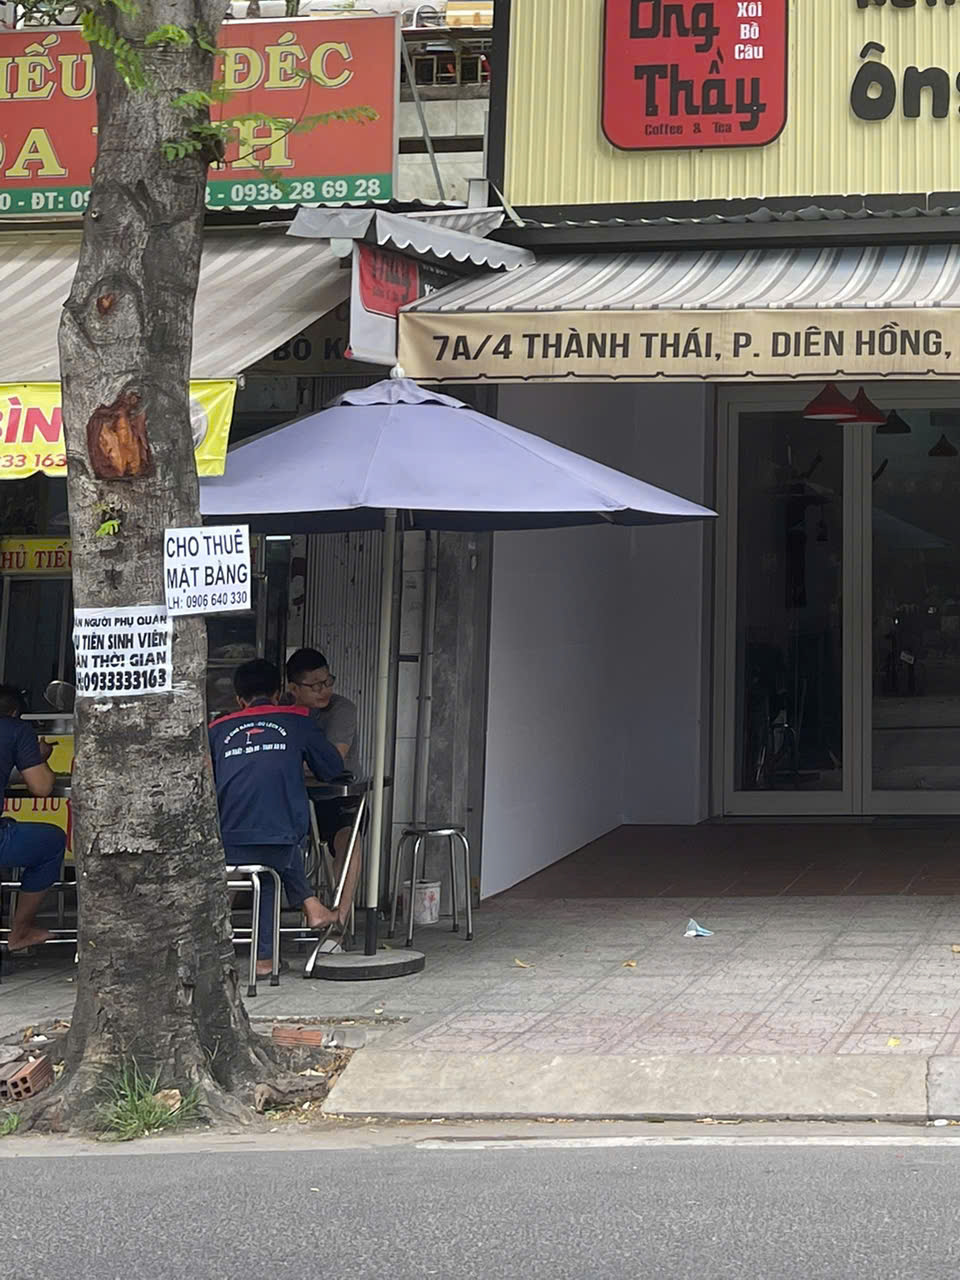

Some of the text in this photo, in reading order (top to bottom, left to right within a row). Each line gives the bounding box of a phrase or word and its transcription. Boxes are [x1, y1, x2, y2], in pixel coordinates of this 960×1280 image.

[737, 1, 762, 17] Xôi
[218, 31, 354, 91] ĐÉC
[734, 43, 764, 60] Câu
[634, 47, 767, 131] Thầy
[644, 121, 732, 136] Coffee & Tea
[0, 127, 69, 179] A
[31, 192, 64, 210] ĐT:
[231, 183, 283, 202] 0938
[288, 181, 316, 200] 28
[321, 180, 348, 199] 69
[354, 178, 381, 197] 28
[432, 334, 513, 361] 7A/4
[522, 326, 630, 359] THÀNH
[639, 326, 722, 362] THÁI,
[733, 332, 760, 359] P.
[771, 325, 844, 358] DIÊN
[854, 321, 952, 359] HỒNG,
[0, 396, 62, 443] ÌN
[34, 453, 67, 467] 163
[166, 536, 200, 558] CHO
[203, 528, 244, 556] THUÊ
[167, 563, 200, 593] MẶT
[168, 591, 248, 610] LH: 0906 640 330
[82, 631, 105, 650] TIÊN
[108, 632, 134, 650] SINH
[137, 629, 168, 649] VIÊN
[129, 650, 167, 667] GIAN
